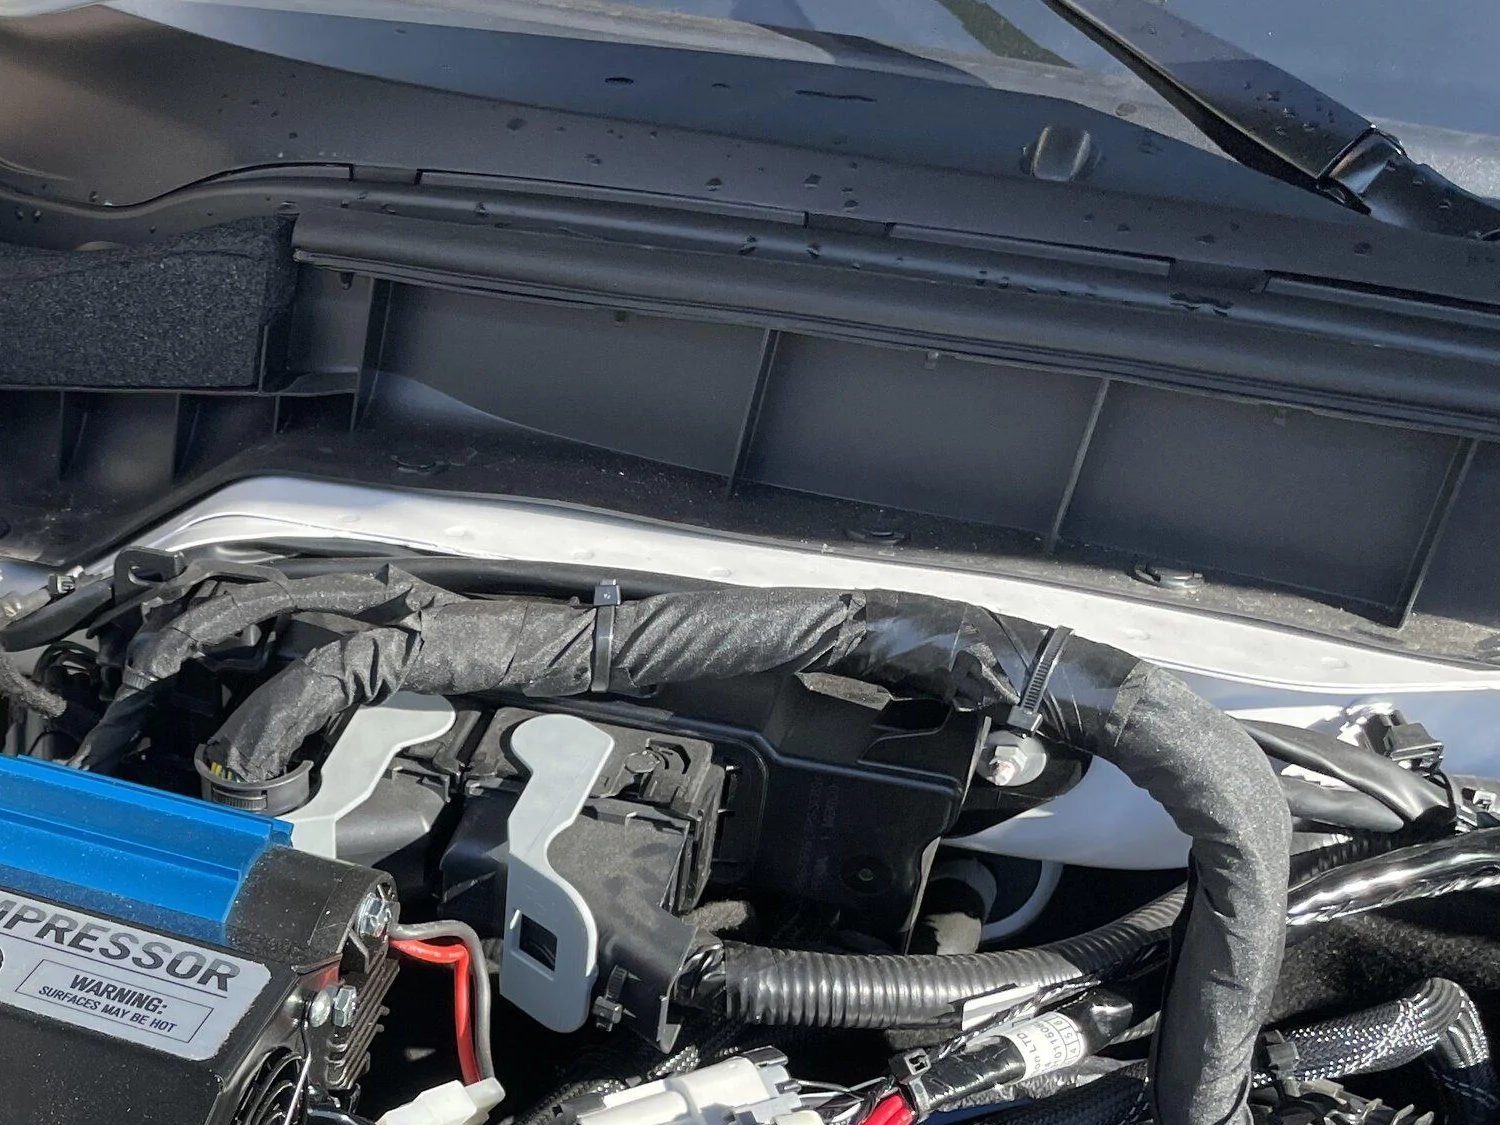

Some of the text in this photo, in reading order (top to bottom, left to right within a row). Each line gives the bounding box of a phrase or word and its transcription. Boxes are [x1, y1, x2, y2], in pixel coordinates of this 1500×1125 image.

[38, 985, 178, 1033] SURFACES MAY BE HOT
[70, 974, 168, 1015] WARNING:
